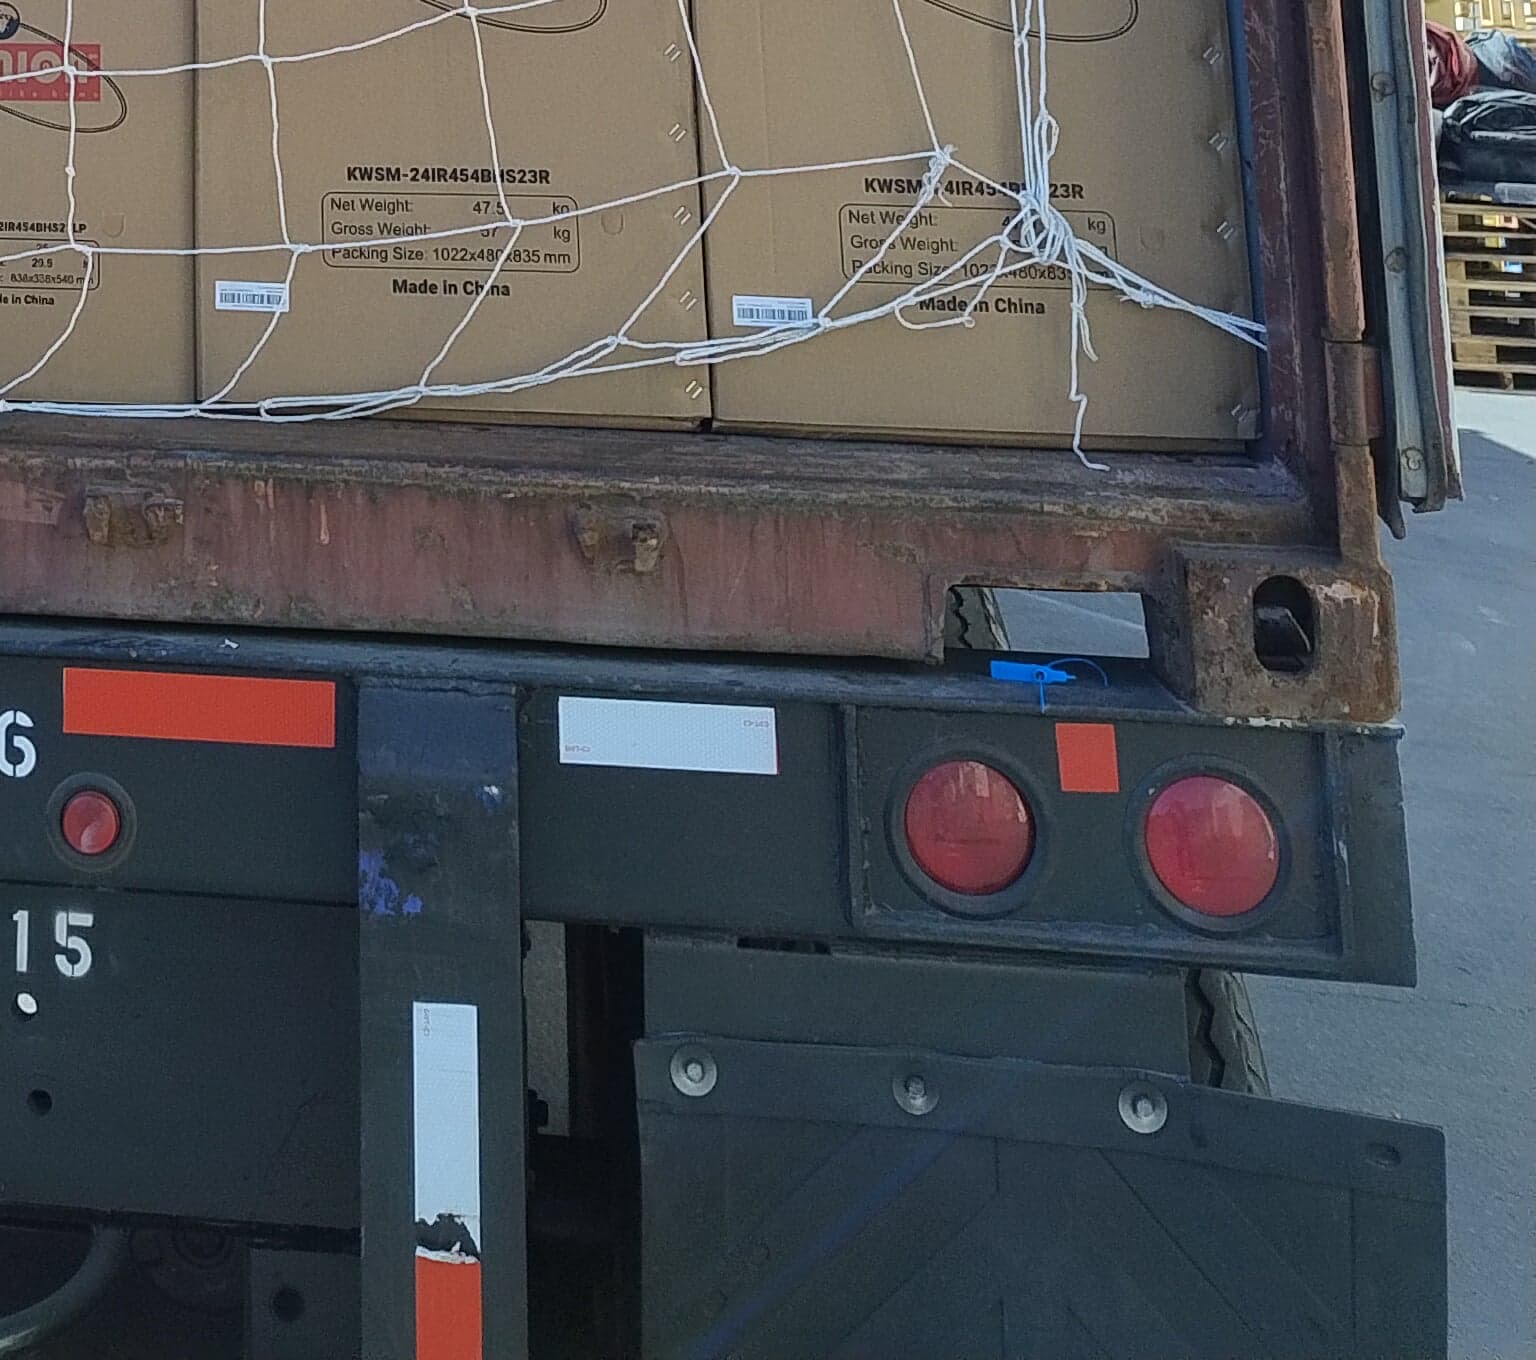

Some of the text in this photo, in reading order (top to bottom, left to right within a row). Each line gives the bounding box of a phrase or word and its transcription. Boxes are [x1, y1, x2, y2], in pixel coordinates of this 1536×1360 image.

[330, 197, 355, 211] Net
[848, 210, 876, 224] Net
[1087, 217, 1106, 233] kg
[331, 222, 374, 236] Gross
[553, 227, 571, 243] kg
[543, 252, 571, 265] mm
[392, 279, 439, 295] Made
[24, 295, 55, 306] China
[919, 296, 1046, 314] Made China
